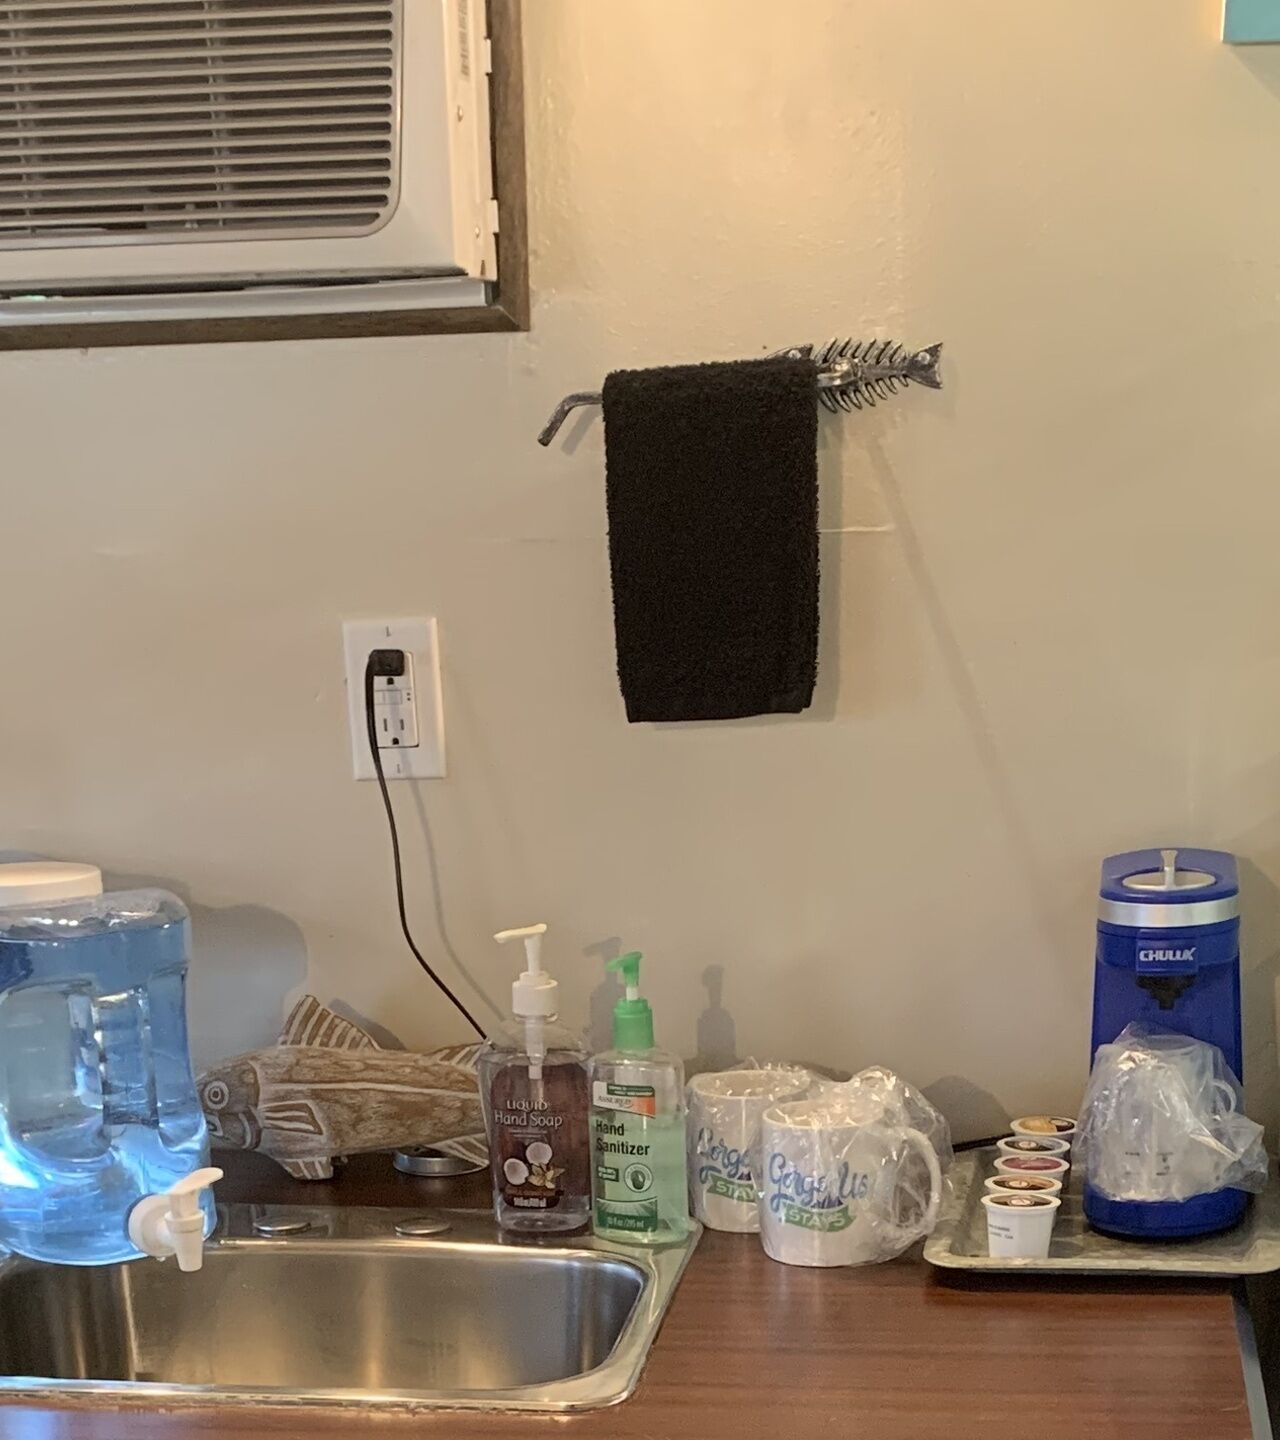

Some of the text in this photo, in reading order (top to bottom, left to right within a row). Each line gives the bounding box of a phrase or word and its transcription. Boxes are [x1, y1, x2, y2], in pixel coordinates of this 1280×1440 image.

[506, 1099, 549, 1111] LIQUID
[494, 1109, 563, 1130] Hand Soap
[595, 1119, 625, 1137] Hand
[596, 1137, 651, 1156] Sanitizer
[715, 1181, 756, 1201] STAY
[789, 1209, 846, 1229] STAYS
